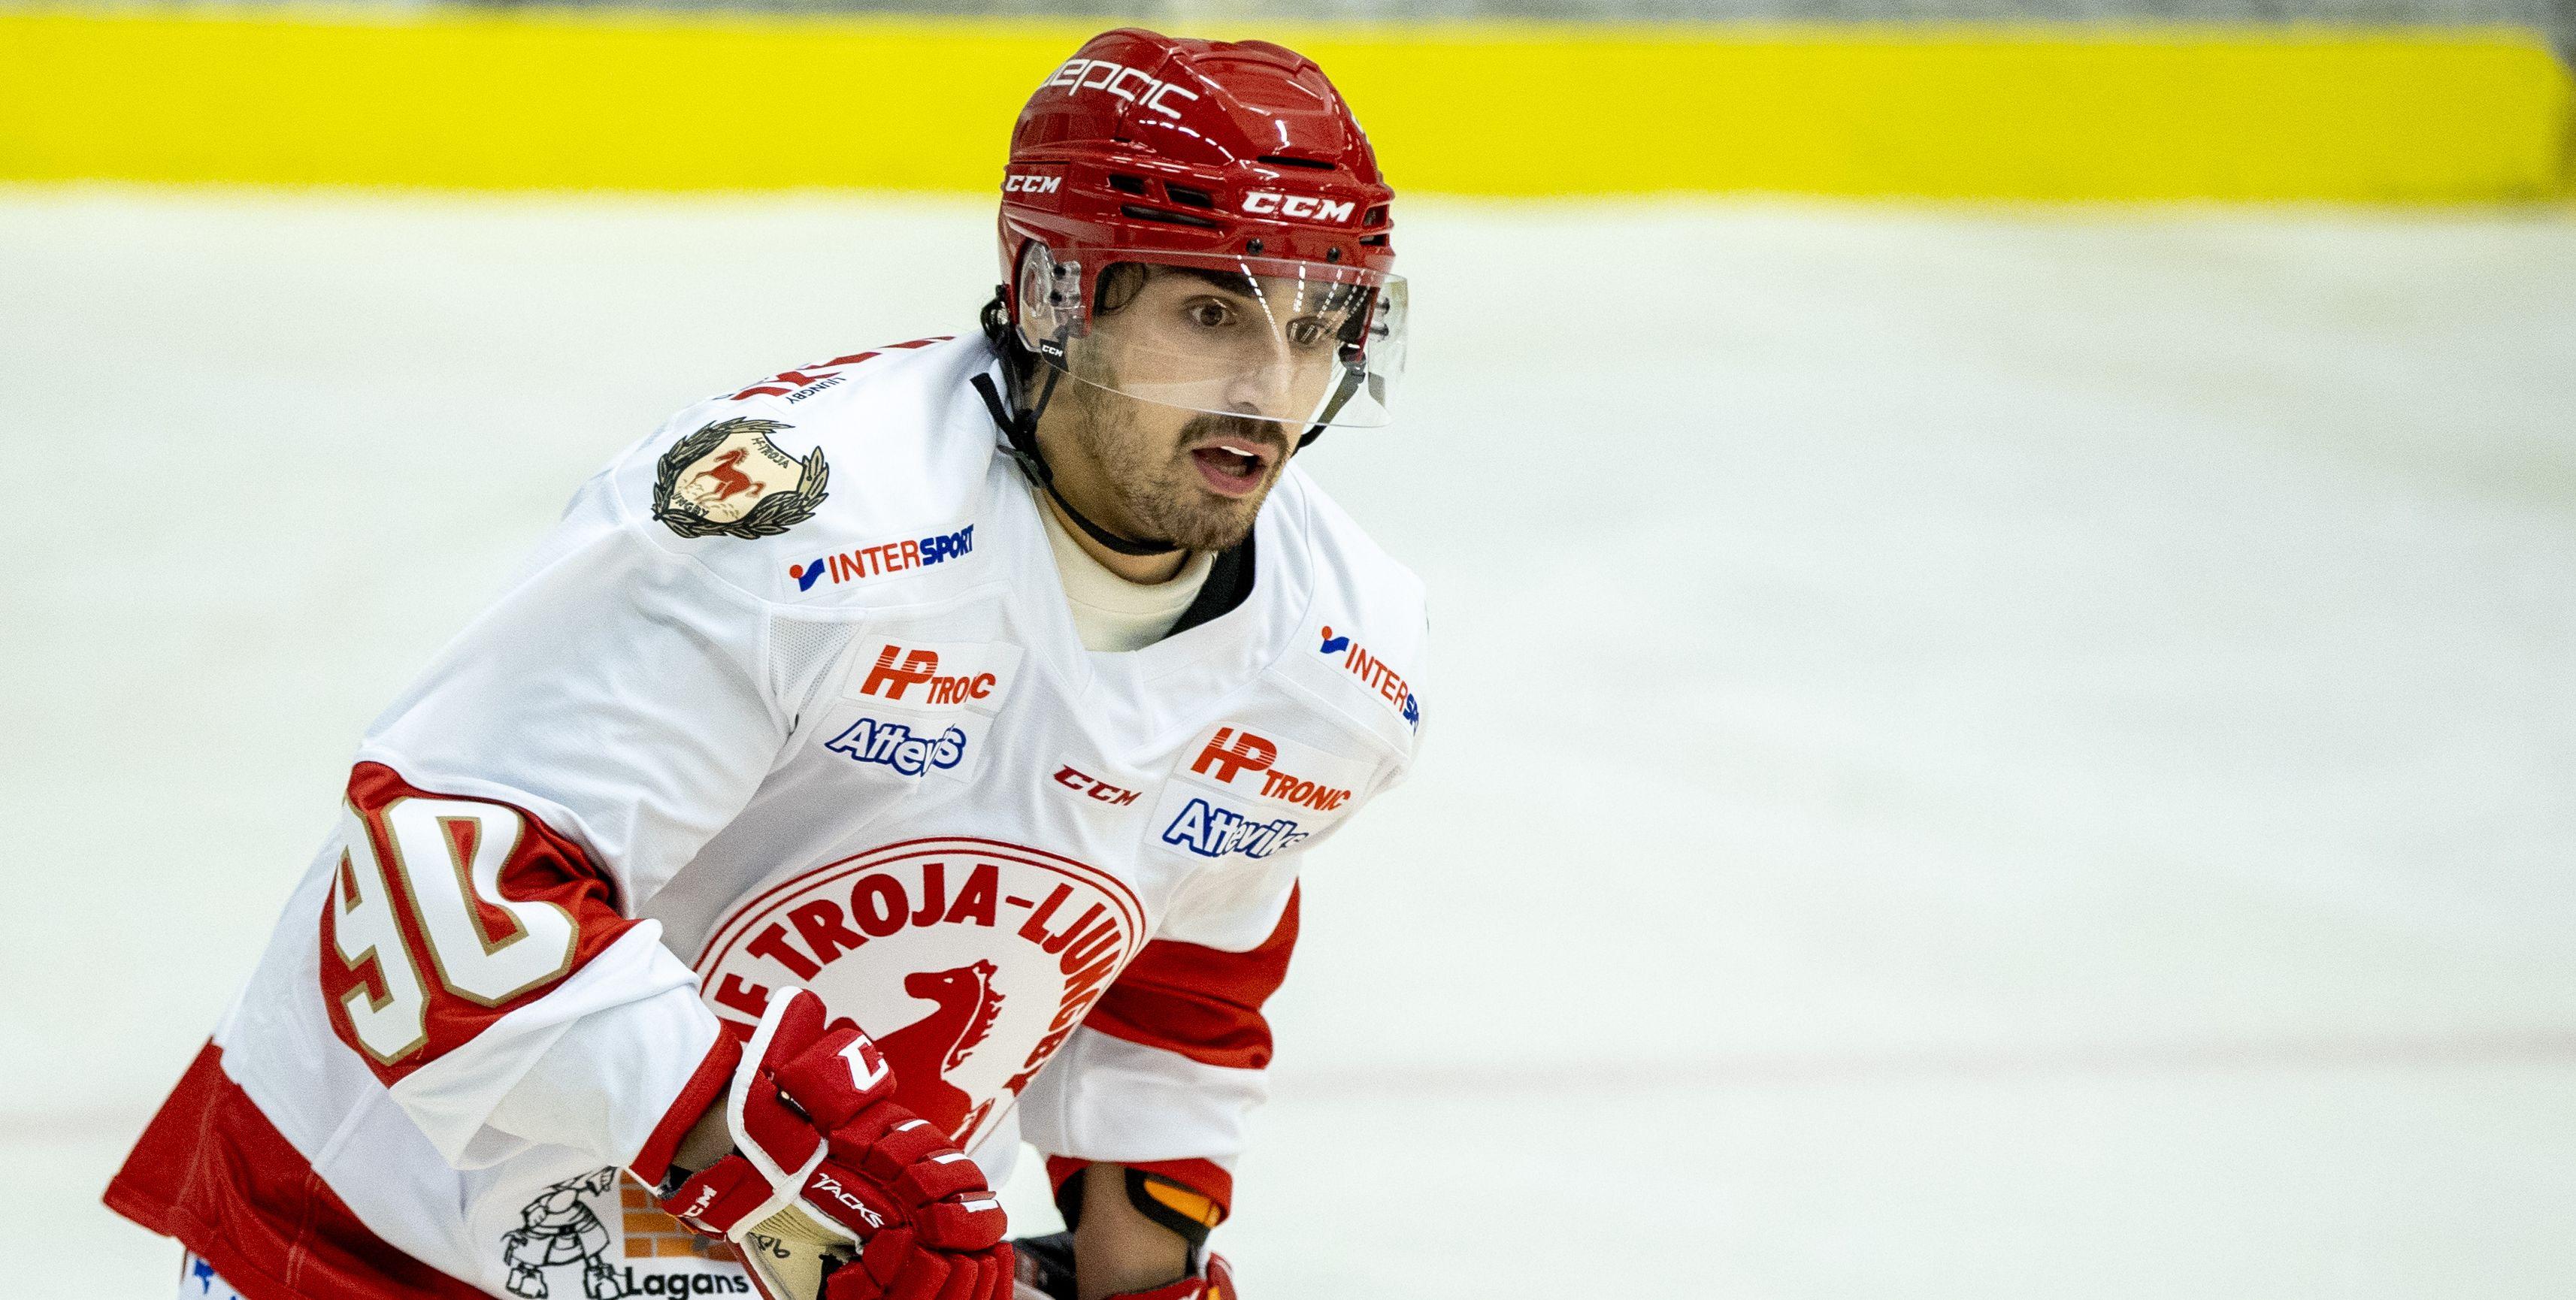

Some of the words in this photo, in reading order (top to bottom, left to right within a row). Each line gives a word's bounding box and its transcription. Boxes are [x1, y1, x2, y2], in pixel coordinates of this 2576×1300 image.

[1005, 175, 1062, 193] CCM
[1241, 191, 1356, 223] CCM
[1042, 344, 1064, 357] CCM
[828, 523, 974, 585] INTERSPORT
[860, 644, 939, 700] HP
[1052, 764, 1143, 806] CCM
[1190, 727, 1278, 784] HP
[1260, 769, 1352, 812] TRONIC
[334, 789, 580, 1066] 90
[678, 1184, 718, 1217] CM
[811, 1172, 885, 1229] TACKS
[625, 1266, 750, 1300] Lagans
